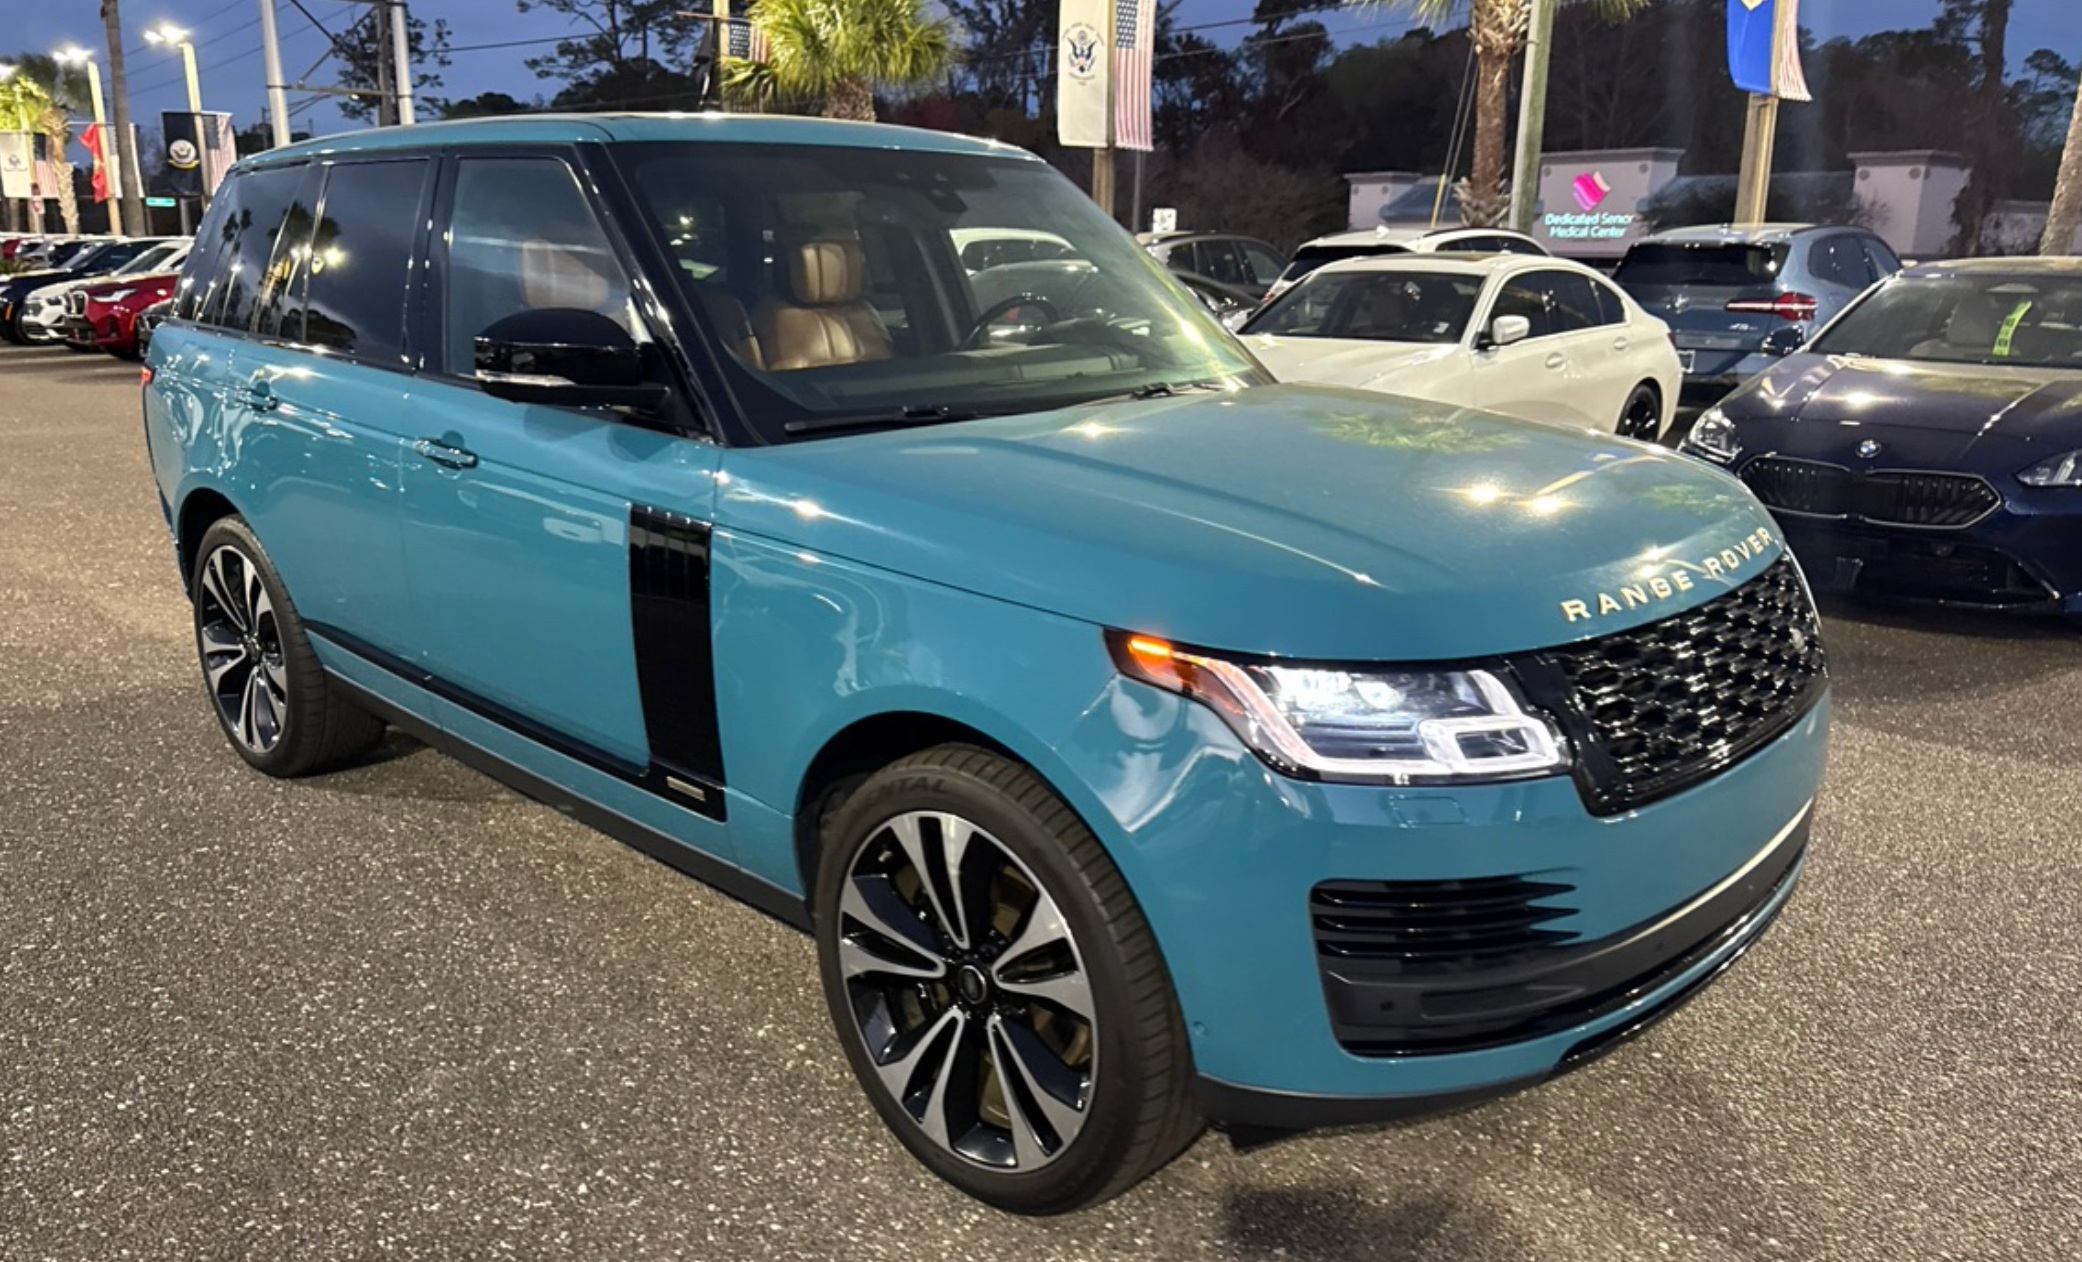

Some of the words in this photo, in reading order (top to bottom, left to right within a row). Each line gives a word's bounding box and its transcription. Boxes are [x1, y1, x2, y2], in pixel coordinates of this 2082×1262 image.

[1545, 212, 1600, 225] Dedicated
[1549, 225, 1589, 238] Medical
[1590, 225, 1626, 238] Center
[1560, 569, 1695, 623] RANGE
[1702, 526, 1774, 577] ROVER
